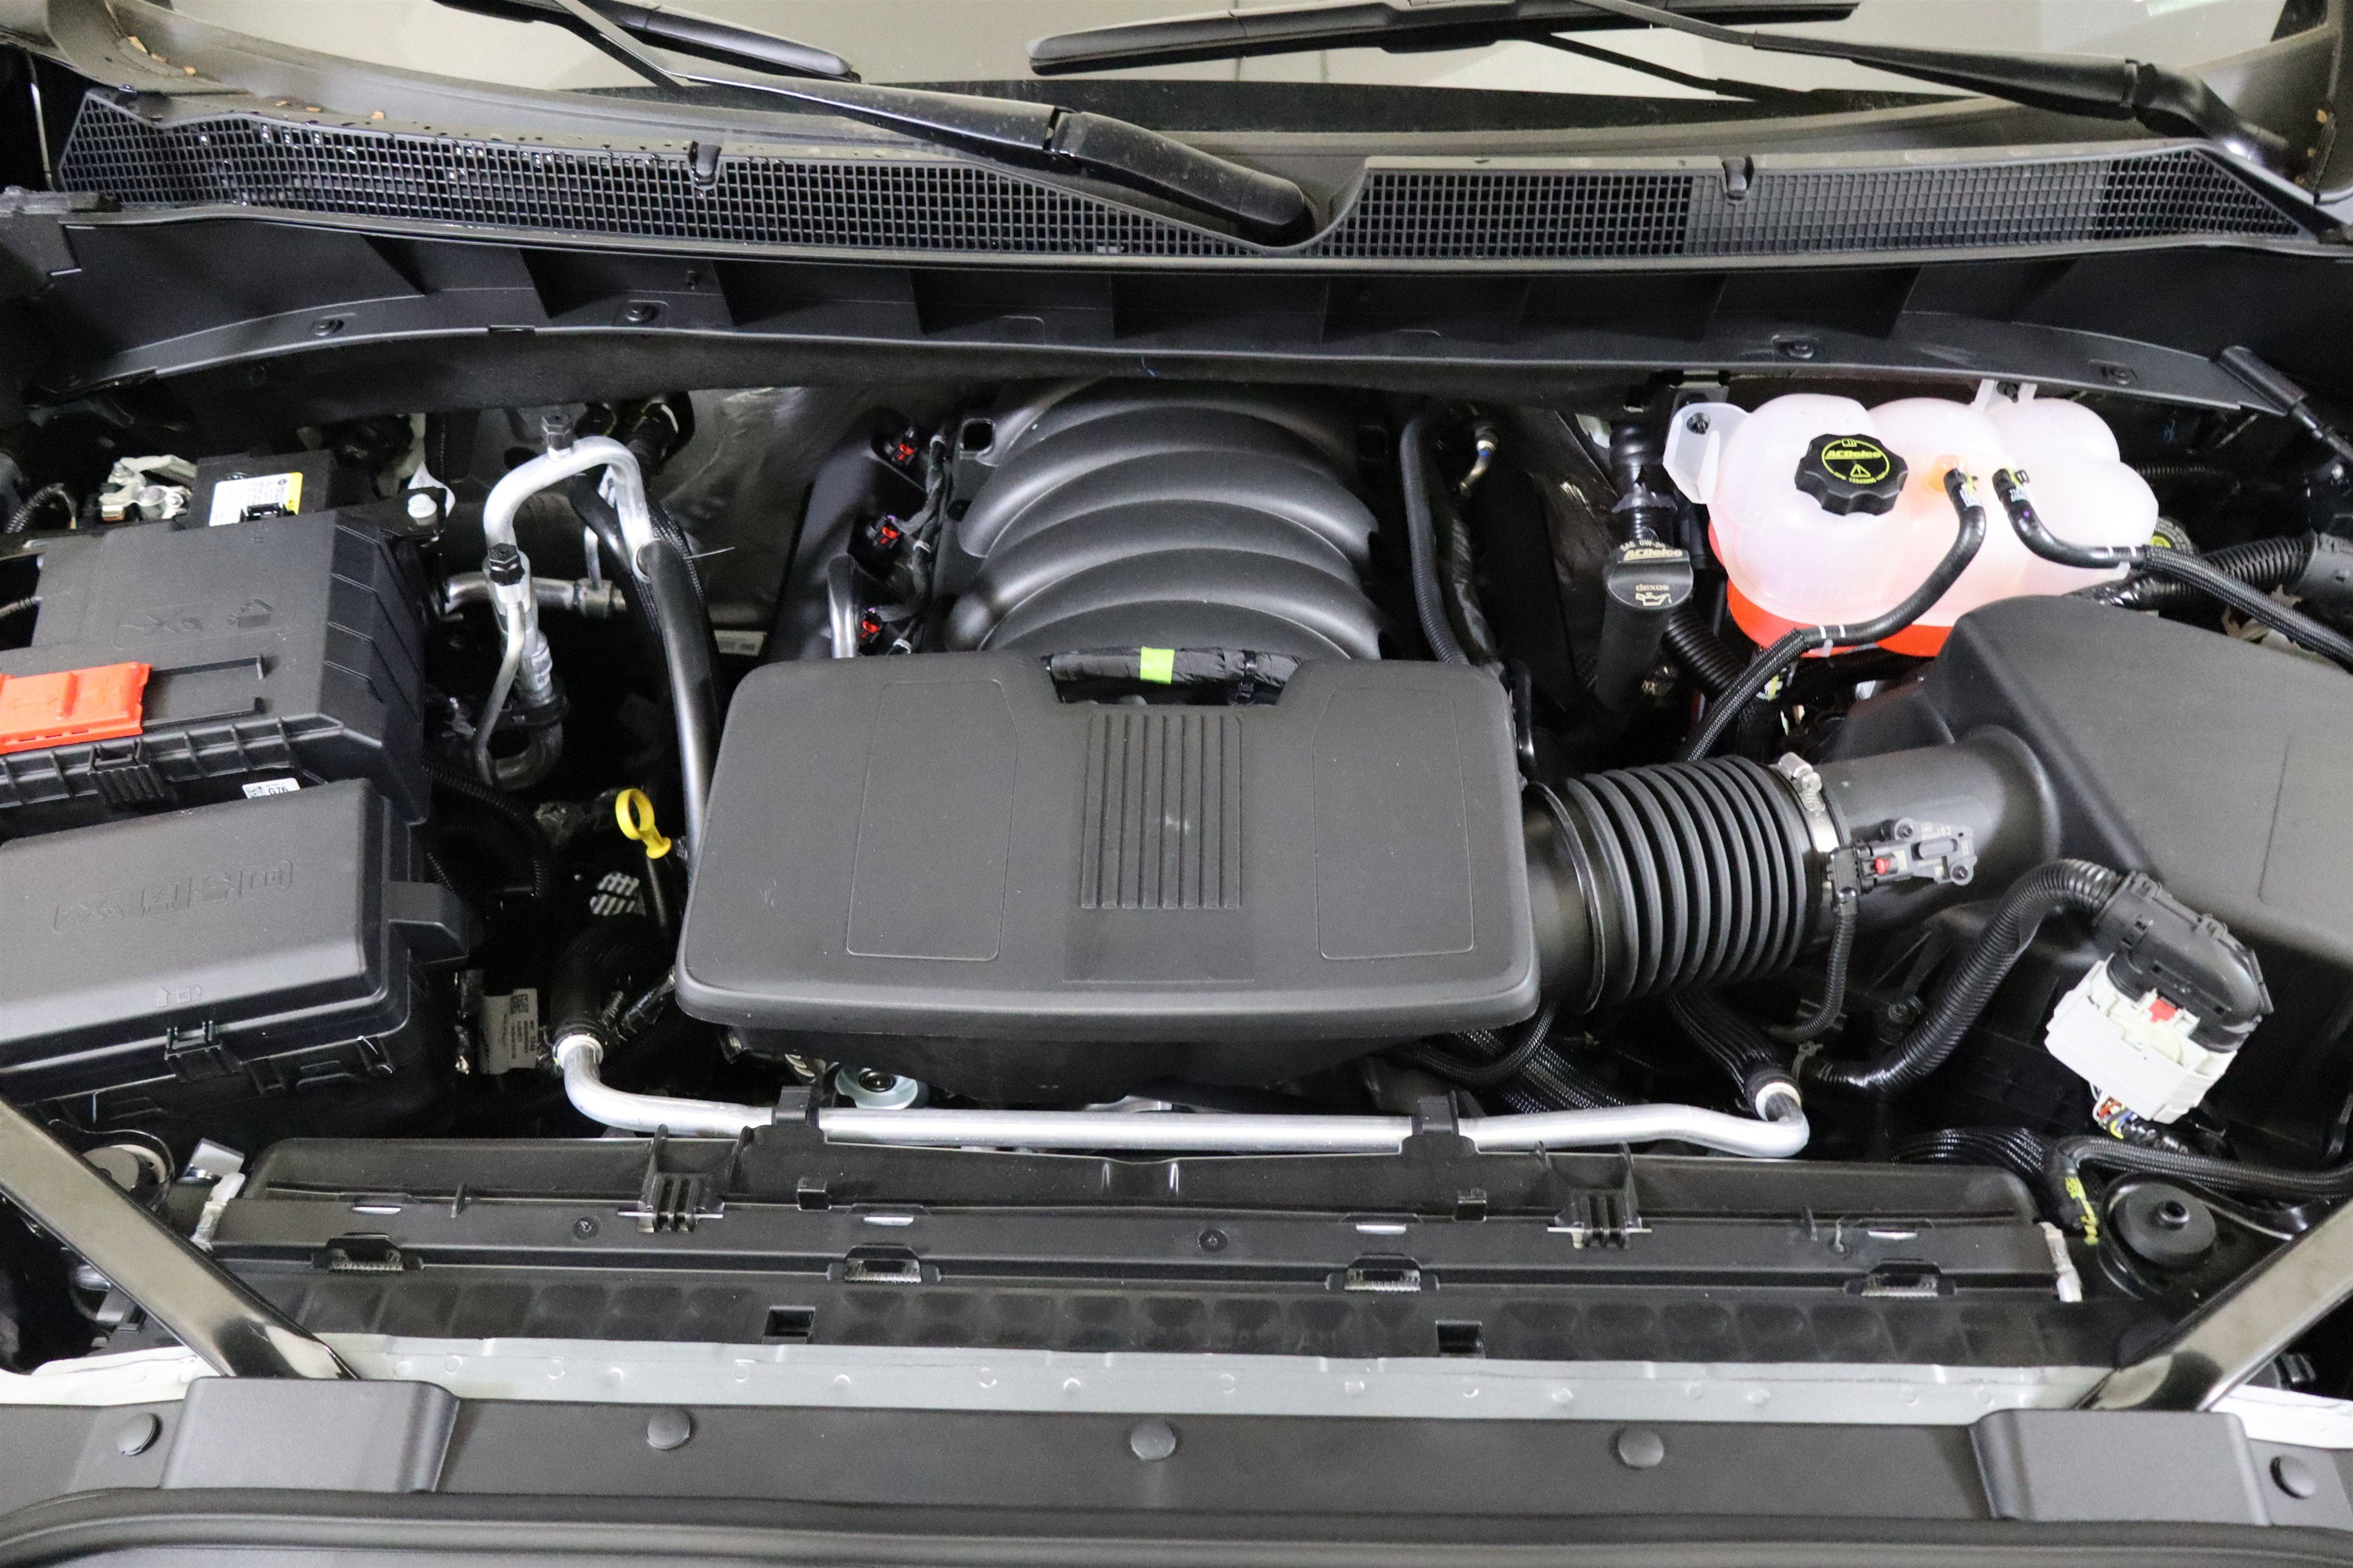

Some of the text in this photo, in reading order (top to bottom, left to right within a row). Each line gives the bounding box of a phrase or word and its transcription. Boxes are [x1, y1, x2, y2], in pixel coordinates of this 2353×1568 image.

[1824, 450, 1881, 460] ACDelco
[1620, 540, 1636, 551] SAE
[1623, 549, 1683, 561] ACDelco
[1635, 583, 1669, 591] dexos
